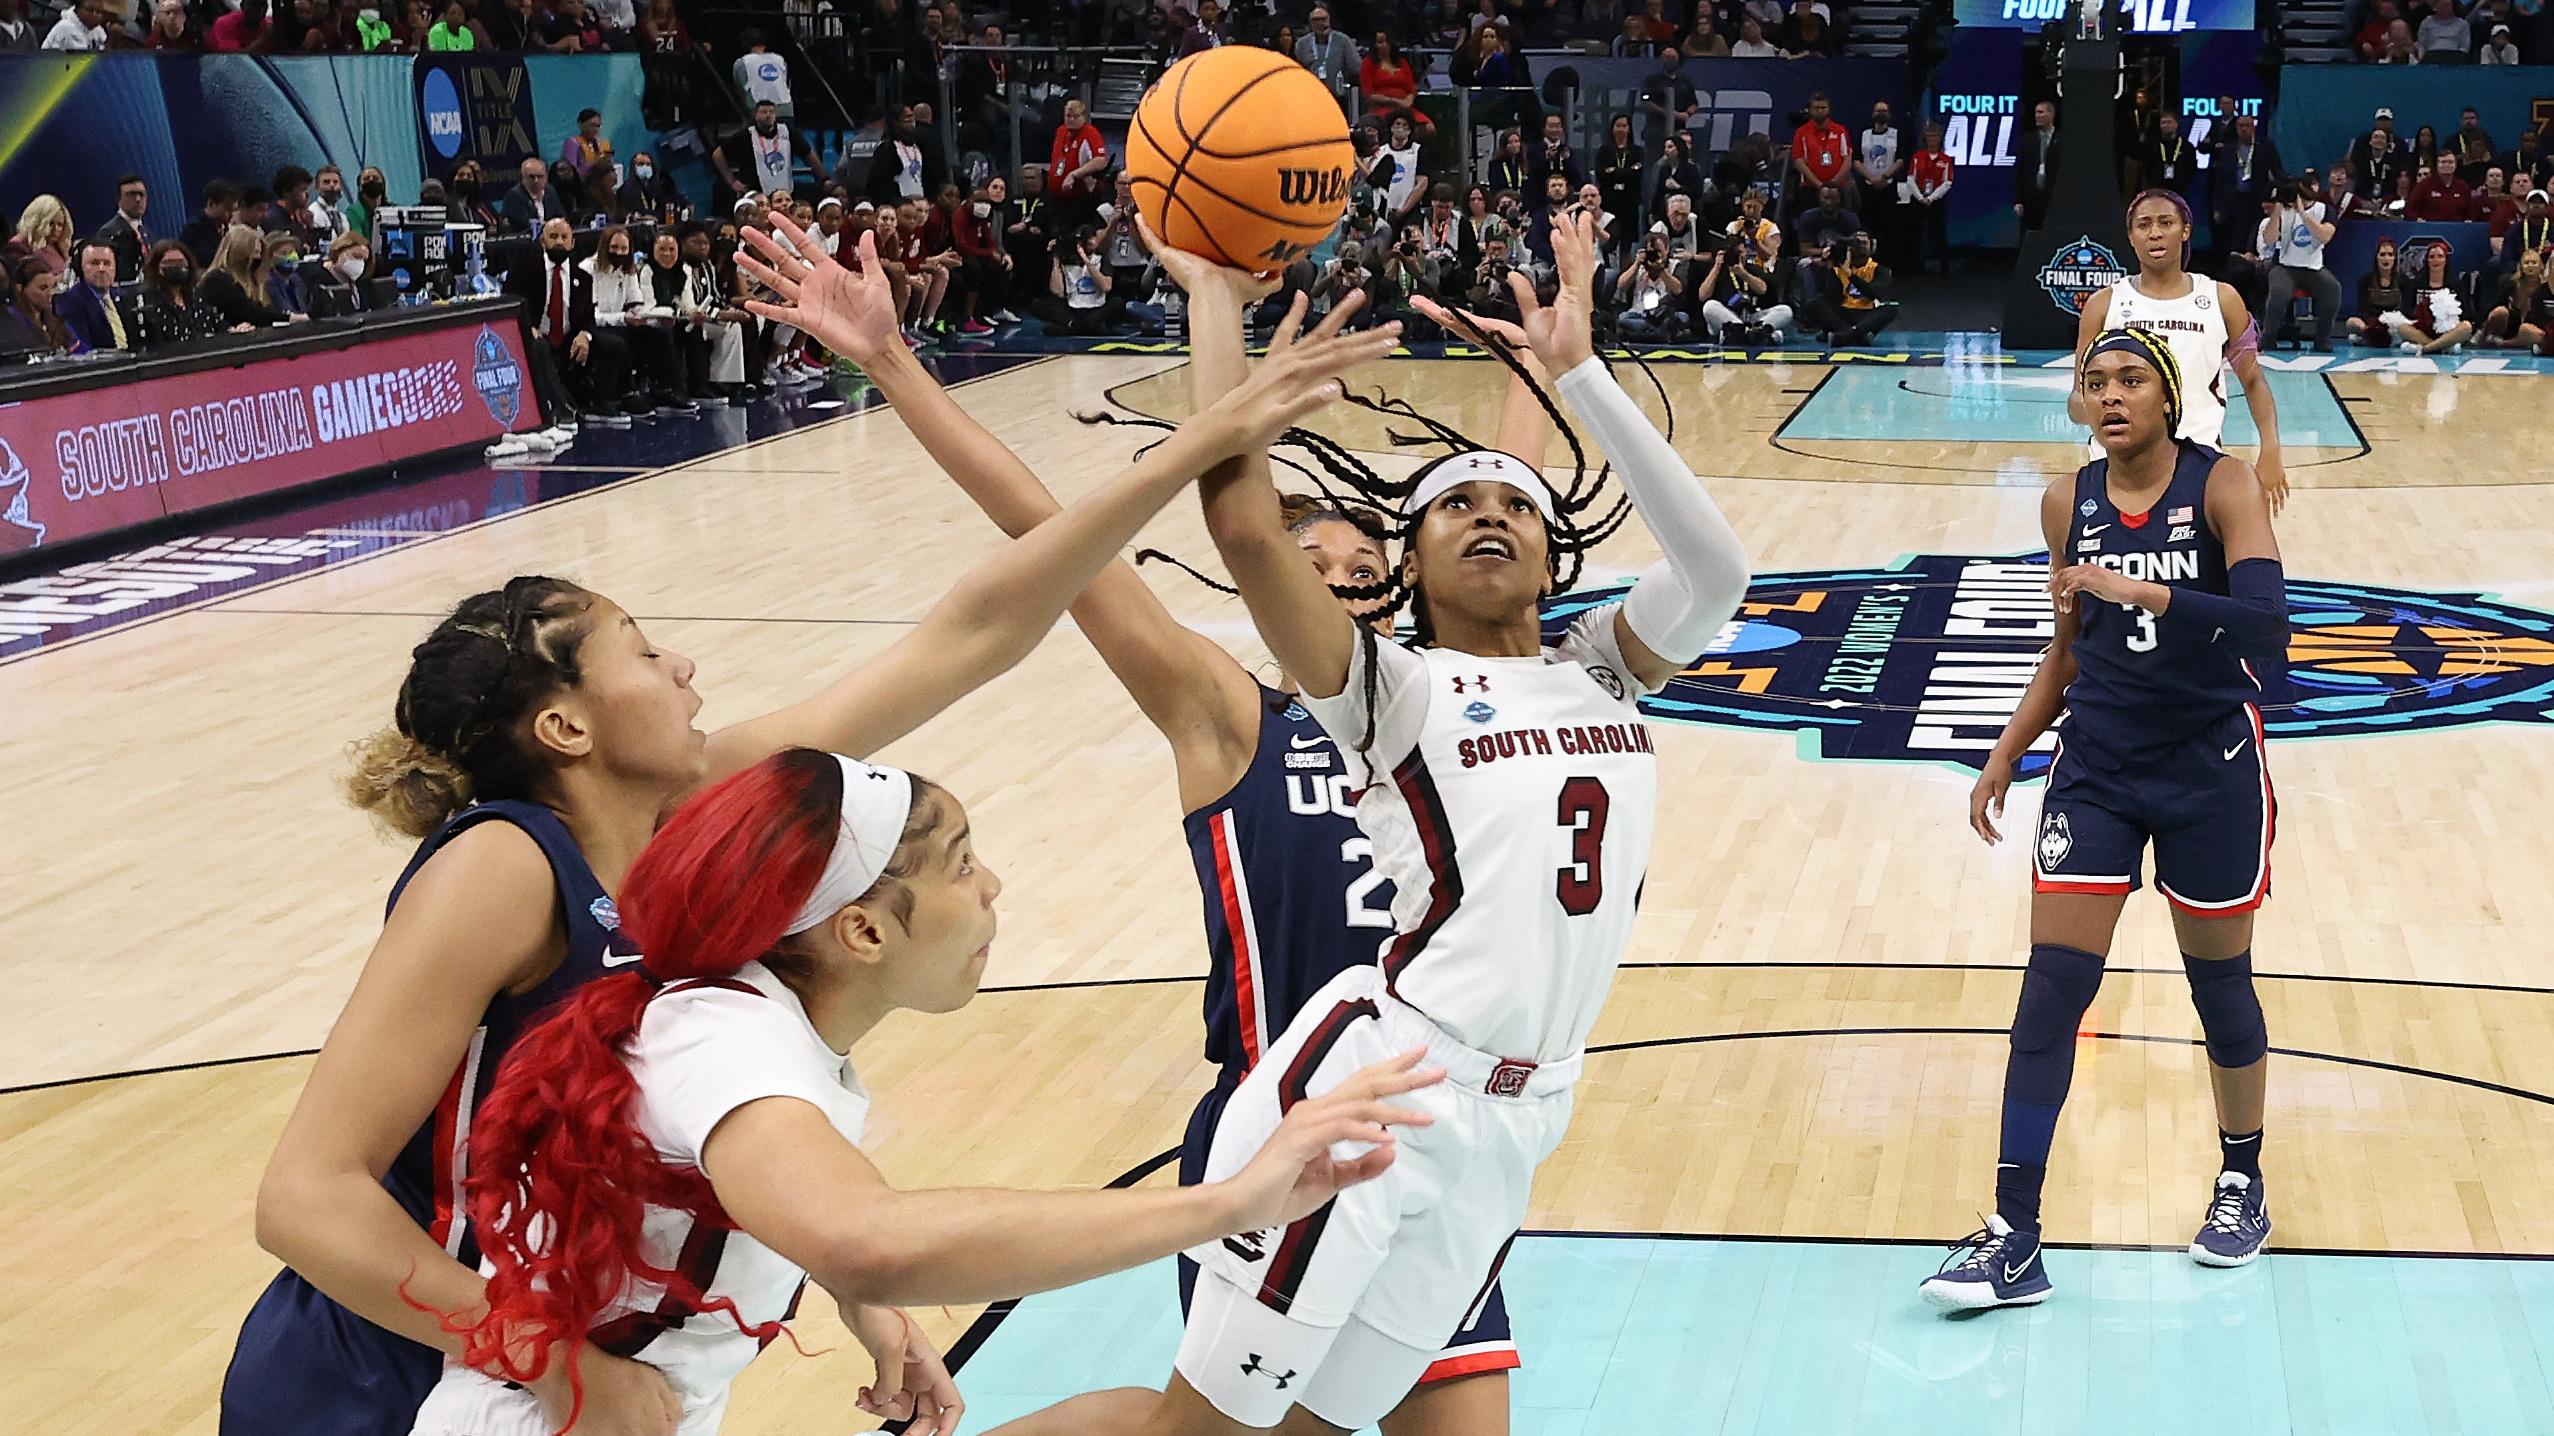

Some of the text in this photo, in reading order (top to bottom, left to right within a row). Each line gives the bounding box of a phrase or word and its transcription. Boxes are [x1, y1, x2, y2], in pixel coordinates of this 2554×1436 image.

[430, 110, 463, 136] NCAA
[1940, 95, 2018, 113] FOUR IT
[2243, 99, 2262, 116] IT
[1943, 115, 2018, 166] ALL
[2045, 270, 2122, 287] FINAL FOUR
[2158, 319, 2205, 334] CAROLINA
[56, 359, 464, 501] SOUTH CAROLINA GAMECOCKS
[2078, 550, 2199, 582] CONN
[1819, 594, 1910, 693] 2022 WOMEN'S
[2121, 603, 2159, 652] 3
[1458, 722, 1655, 768] SOUTH CAROLIN
[1285, 774, 1357, 819] UC
[1556, 776, 1610, 916] 3
